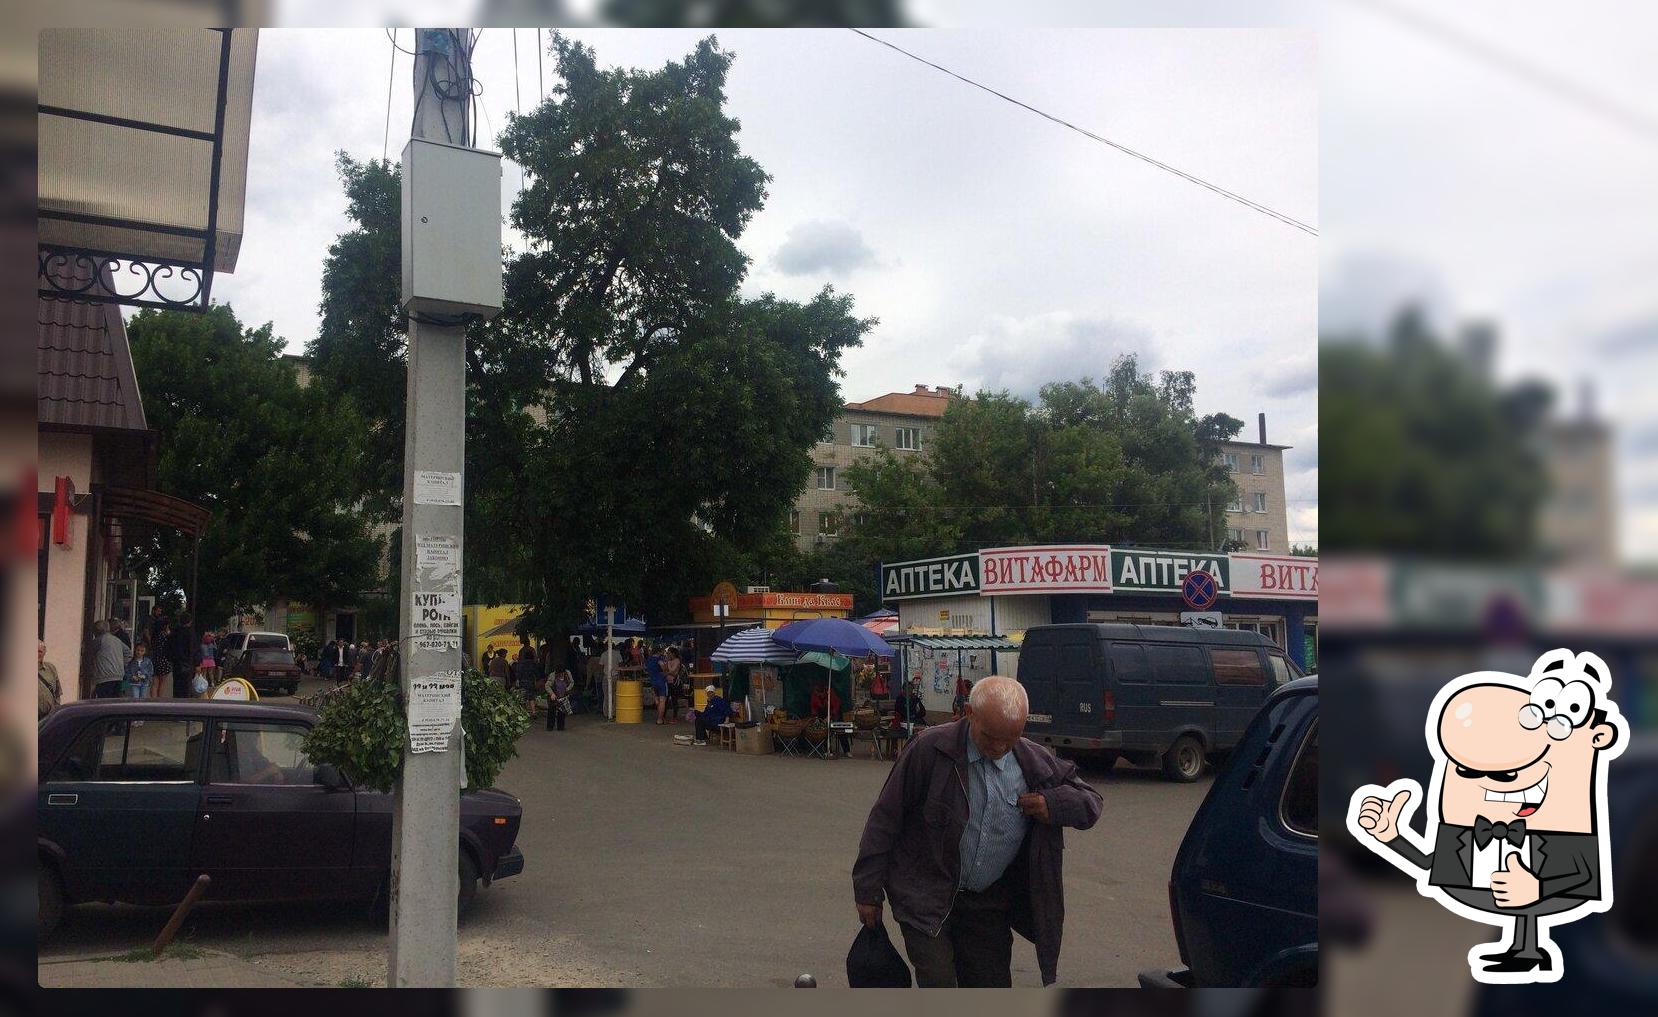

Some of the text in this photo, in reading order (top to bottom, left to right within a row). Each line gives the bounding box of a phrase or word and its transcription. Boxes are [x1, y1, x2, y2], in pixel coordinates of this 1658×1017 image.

[886, 561, 976, 595] АПТЕКА
[984, 555, 1108, 586] ВИТАФАРМ
[1080, 703, 1092, 713] RUS
